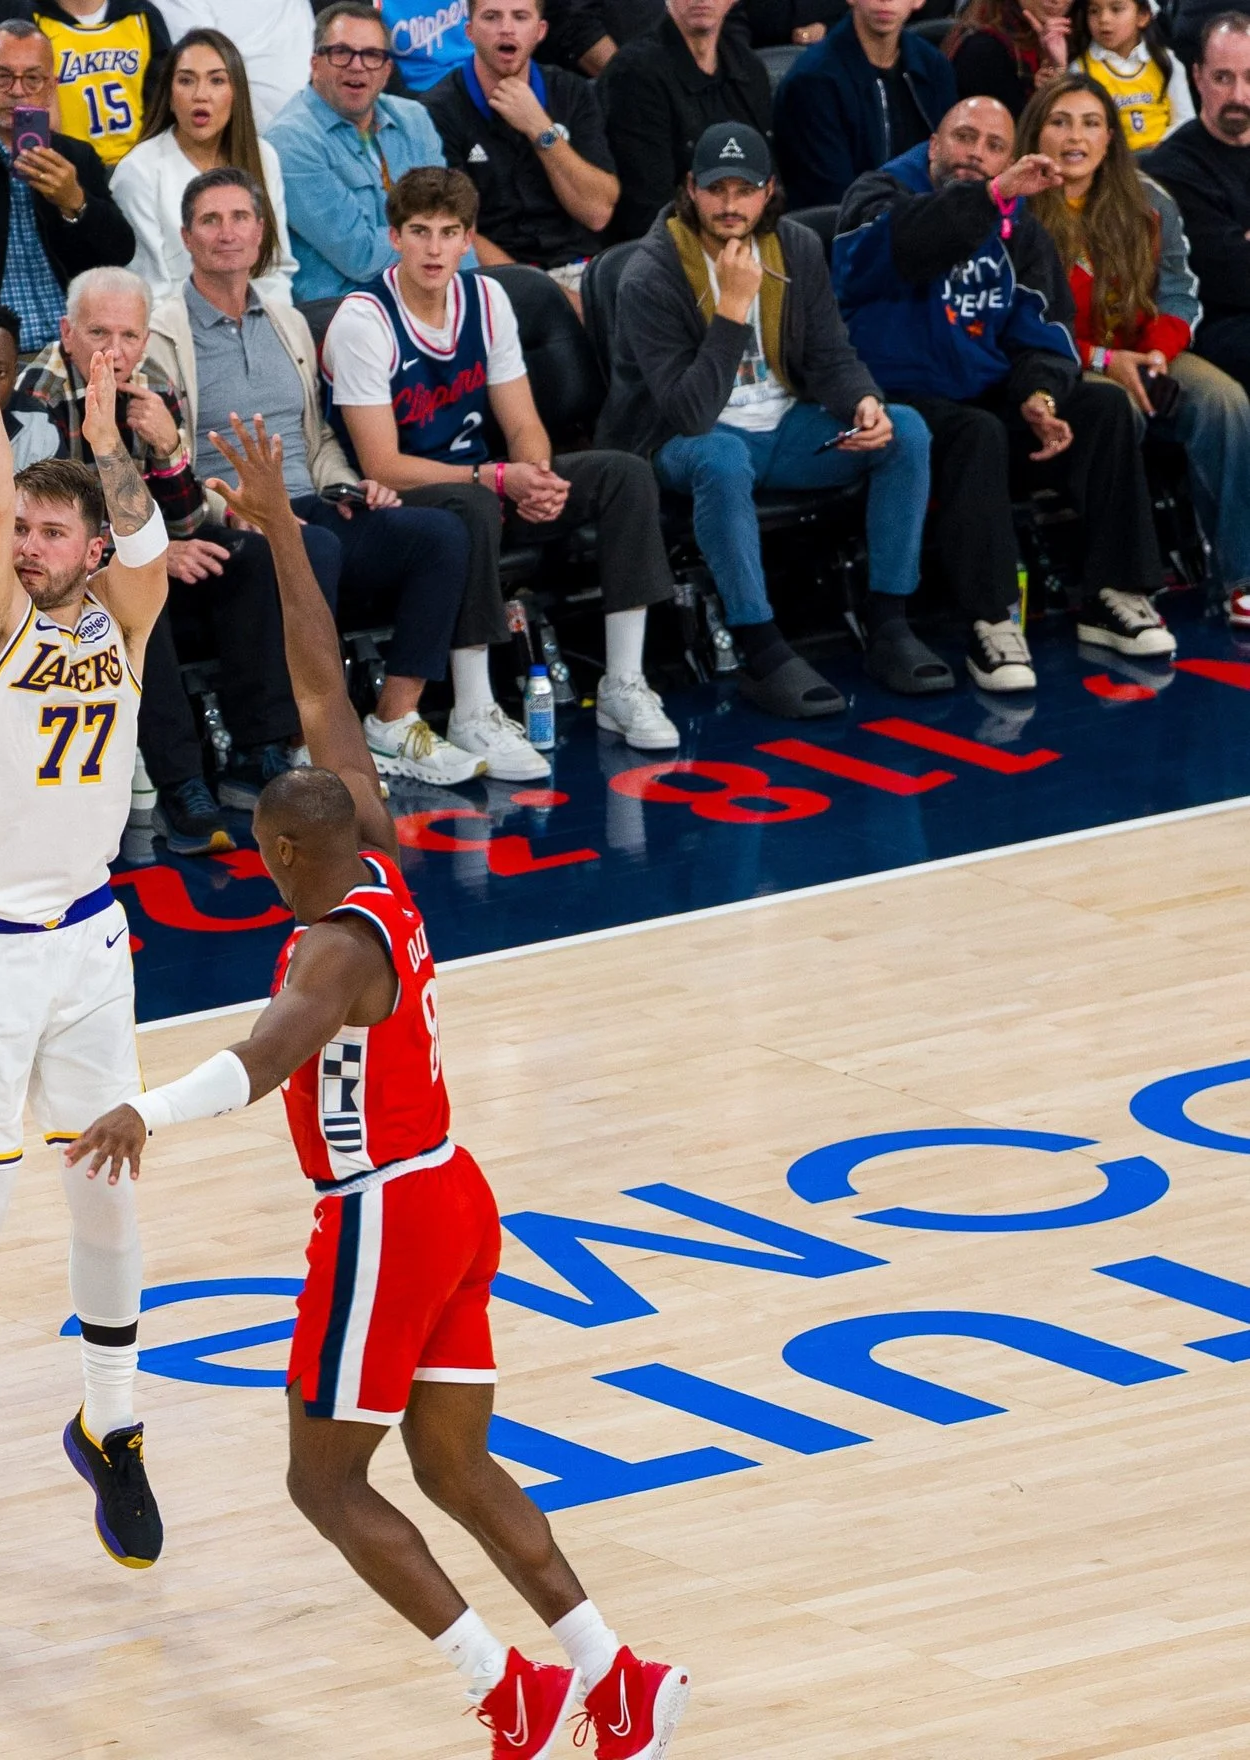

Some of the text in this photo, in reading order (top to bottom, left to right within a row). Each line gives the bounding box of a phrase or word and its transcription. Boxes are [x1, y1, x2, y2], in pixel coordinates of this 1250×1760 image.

[57, 49, 140, 84] LAKERS
[83, 82, 134, 136] 15
[450, 411, 482, 451] 2
[79, 616, 107, 640] bibigo
[35, 700, 119, 787] 77
